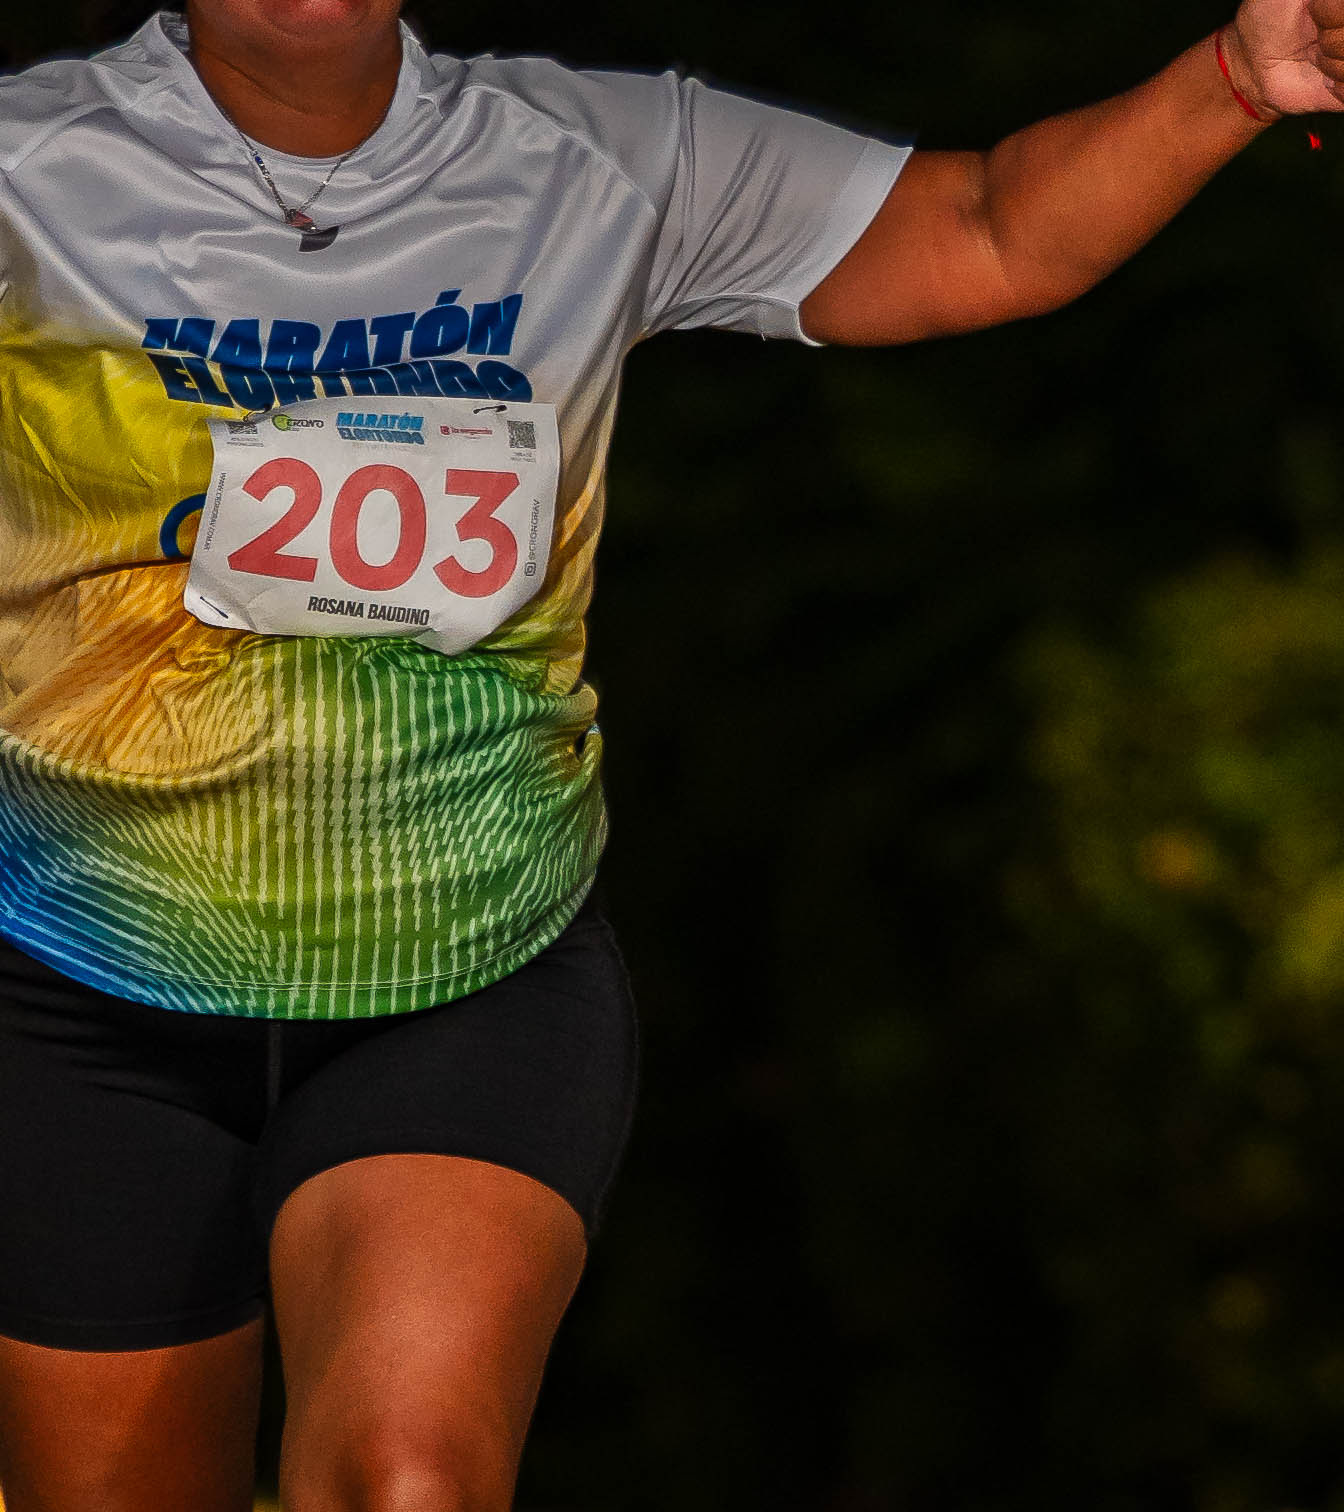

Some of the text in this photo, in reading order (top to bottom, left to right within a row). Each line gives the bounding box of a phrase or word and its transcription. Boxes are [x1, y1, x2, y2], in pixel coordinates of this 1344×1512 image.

[142, 289, 524, 373] MARATÓN
[336, 412, 424, 431] MARATÓN
[227, 457, 520, 598] 203
[307, 596, 430, 626] ROSANA BAUDINO
